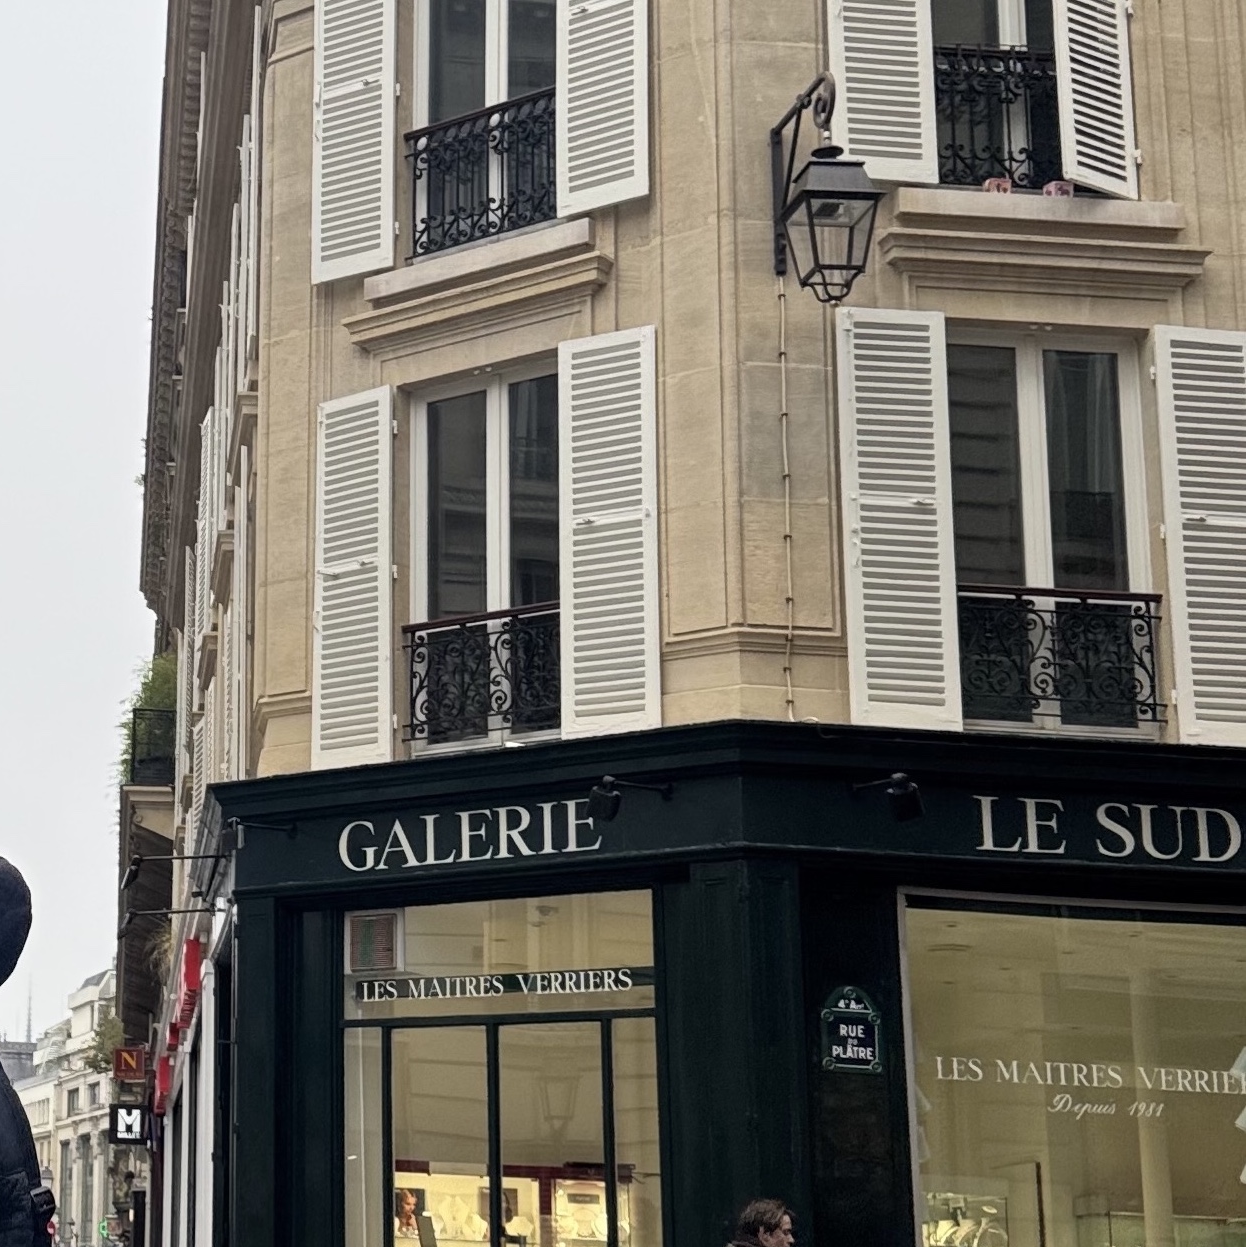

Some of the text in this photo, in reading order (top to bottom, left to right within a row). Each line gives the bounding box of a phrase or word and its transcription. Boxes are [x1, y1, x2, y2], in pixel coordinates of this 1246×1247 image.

[338, 798, 603, 872] GALERIE
[972, 795, 1242, 862] LE SUD
[362, 968, 633, 1002] LES MAITRES VERRIERS
[839, 1024, 865, 1038] RUE
[120, 1051, 138, 1070] N
[831, 1043, 875, 1060] PLÂTRE
[936, 1056, 984, 1081] LES
[995, 1059, 1123, 1088] MAITRES
[1047, 1094, 1165, 1120] Depuis 1981
